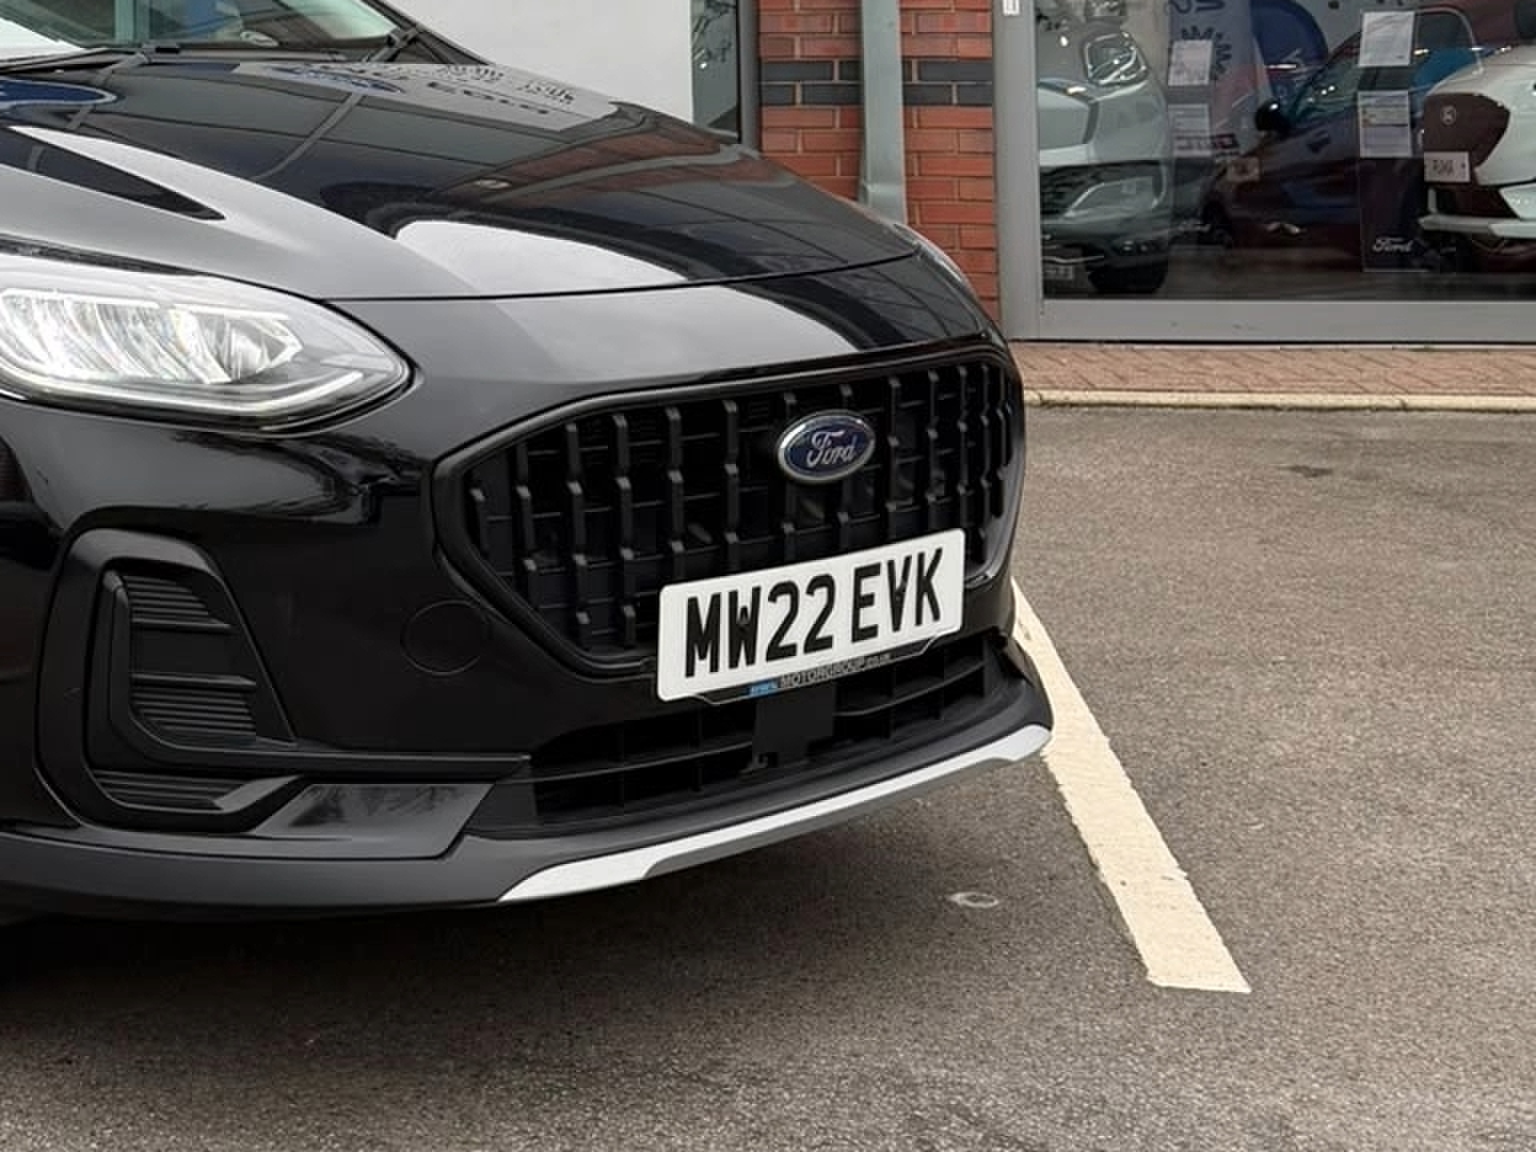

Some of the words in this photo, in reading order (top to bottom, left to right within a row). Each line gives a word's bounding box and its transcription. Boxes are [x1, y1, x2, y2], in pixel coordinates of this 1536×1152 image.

[805, 429, 859, 467] Ford
[684, 572, 838, 679] MW22
[850, 547, 944, 644] EVK
